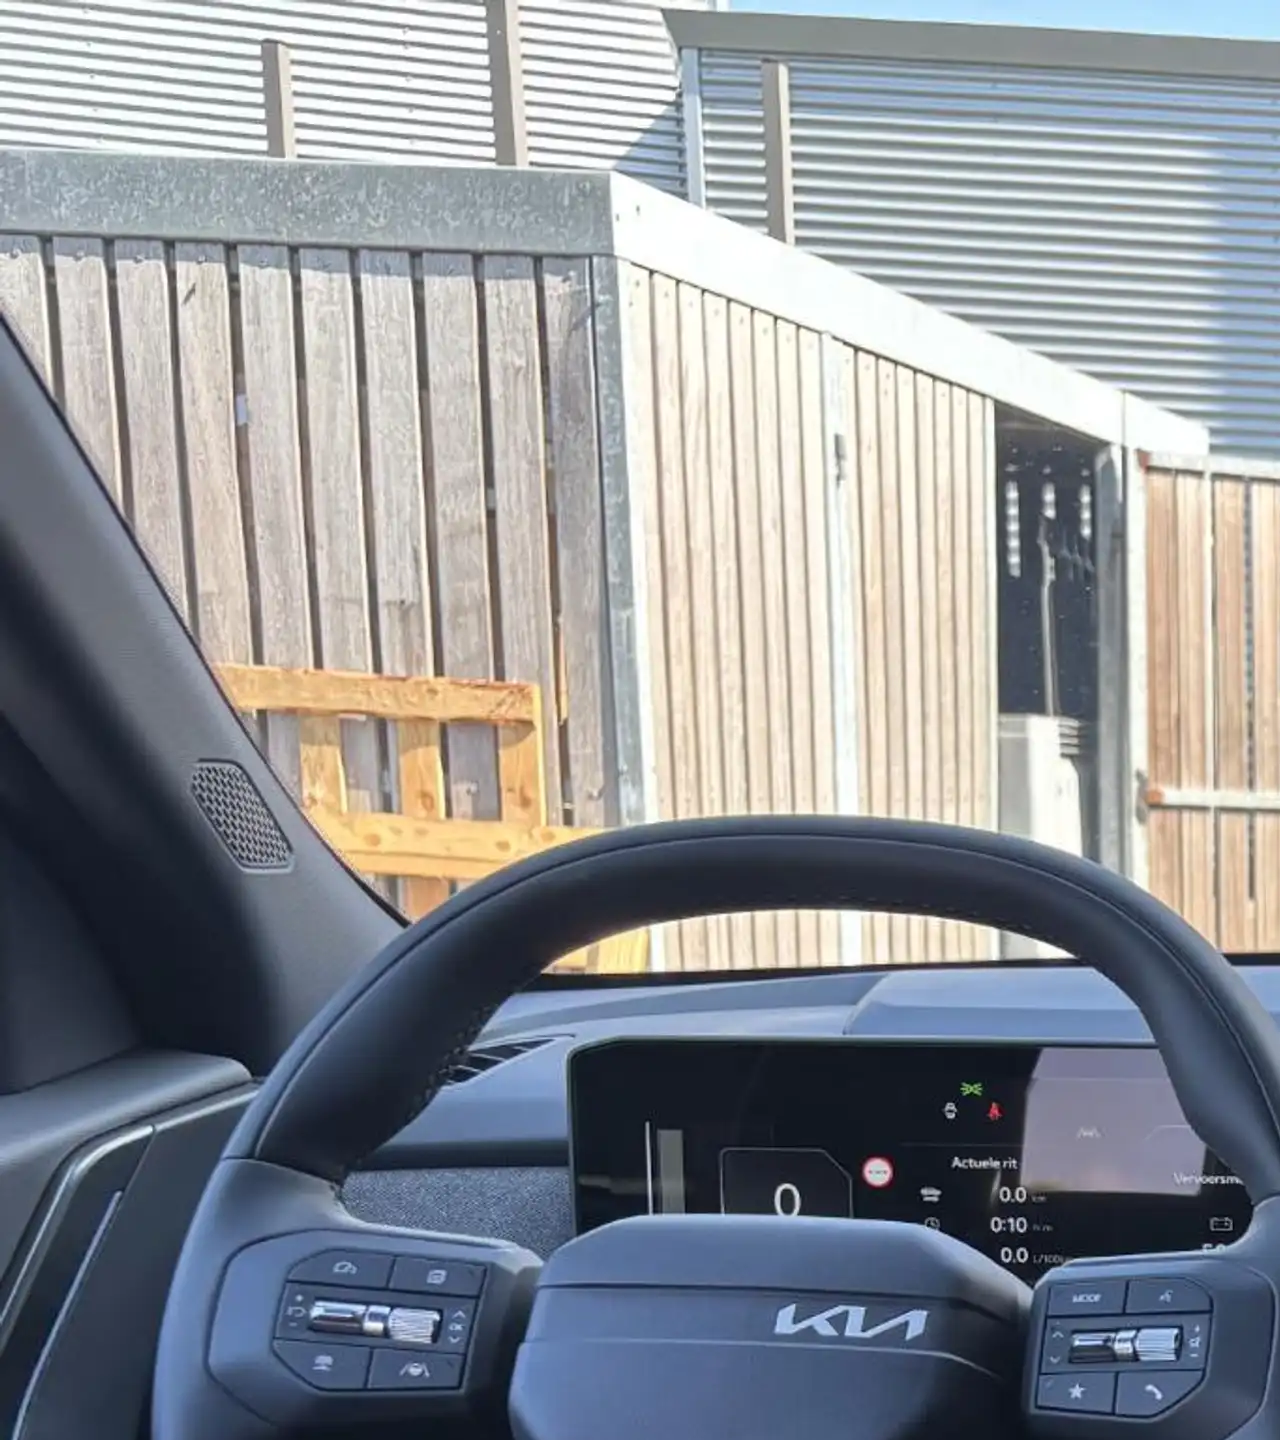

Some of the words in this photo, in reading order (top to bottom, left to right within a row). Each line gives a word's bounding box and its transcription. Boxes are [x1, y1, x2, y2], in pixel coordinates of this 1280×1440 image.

[952, 1156, 1001, 1170] Actuele
[1002, 1156, 1018, 1170] rit
[1000, 1186, 1027, 1203] 0.0
[990, 1216, 1028, 1233] 0:10
[1001, 1246, 1029, 1263] 0.0
[774, 1303, 930, 1341] KIA
